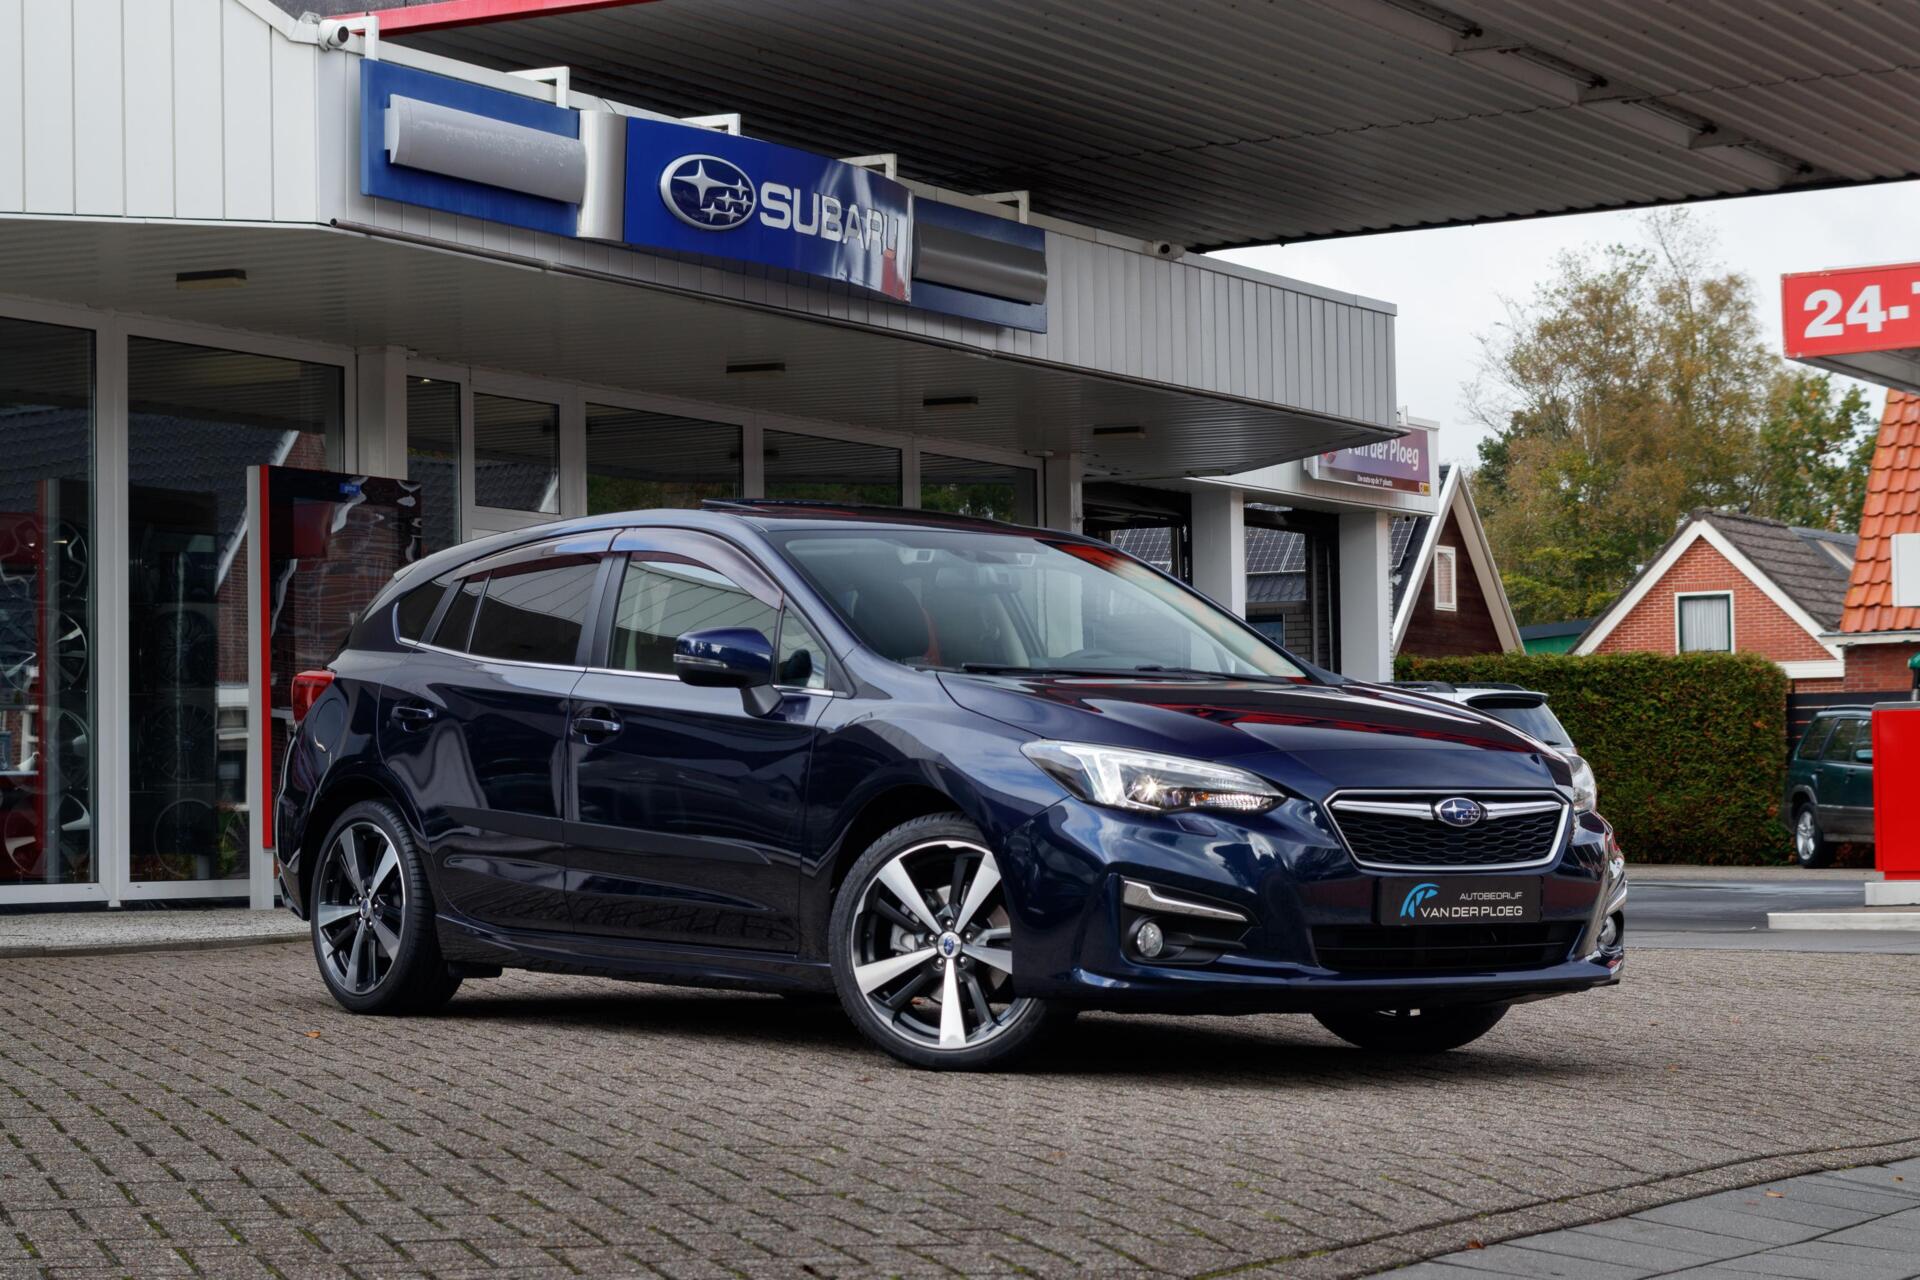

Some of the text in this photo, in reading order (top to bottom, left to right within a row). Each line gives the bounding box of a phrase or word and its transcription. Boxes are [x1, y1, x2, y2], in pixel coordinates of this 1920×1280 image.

[760, 181, 898, 260] SUBARU
[1803, 281, 1920, 339] 24-
[1370, 442, 1388, 461] der
[1390, 439, 1419, 471] Ploeg
[1420, 905, 1523, 918] VAN DER PLOEG
[1459, 891, 1523, 901] AUTOBEDRIJF
